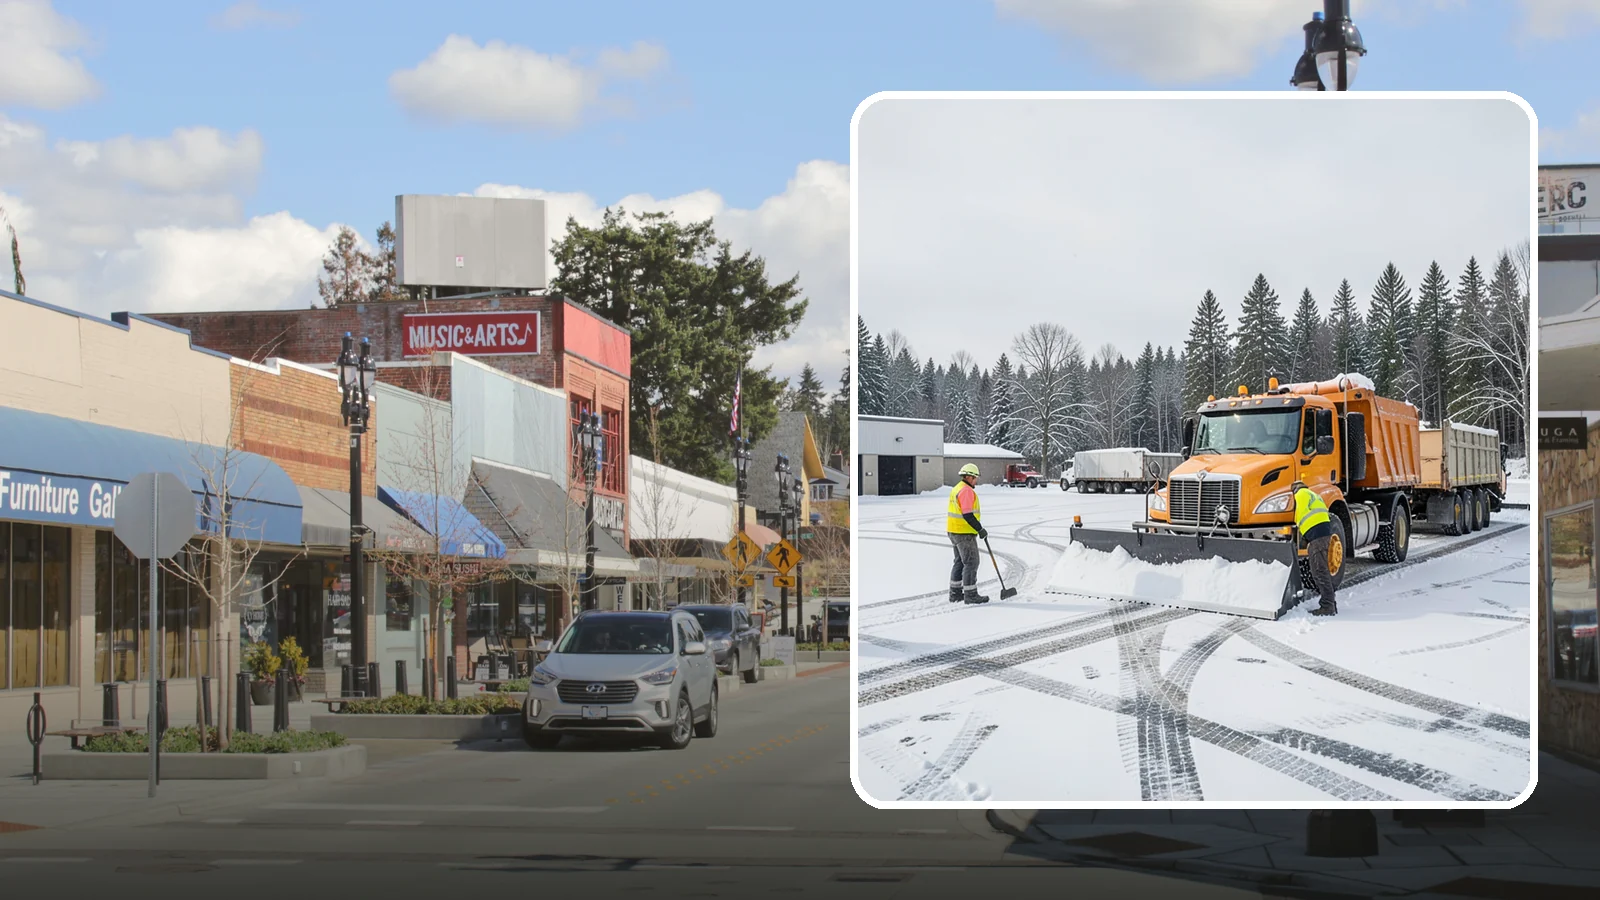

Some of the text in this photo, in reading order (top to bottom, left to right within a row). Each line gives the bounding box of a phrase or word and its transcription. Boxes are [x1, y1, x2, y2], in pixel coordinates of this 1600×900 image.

[408, 322, 520, 349] MUSIC&ARTS
[0, 471, 122, 519] Furniture Gal
